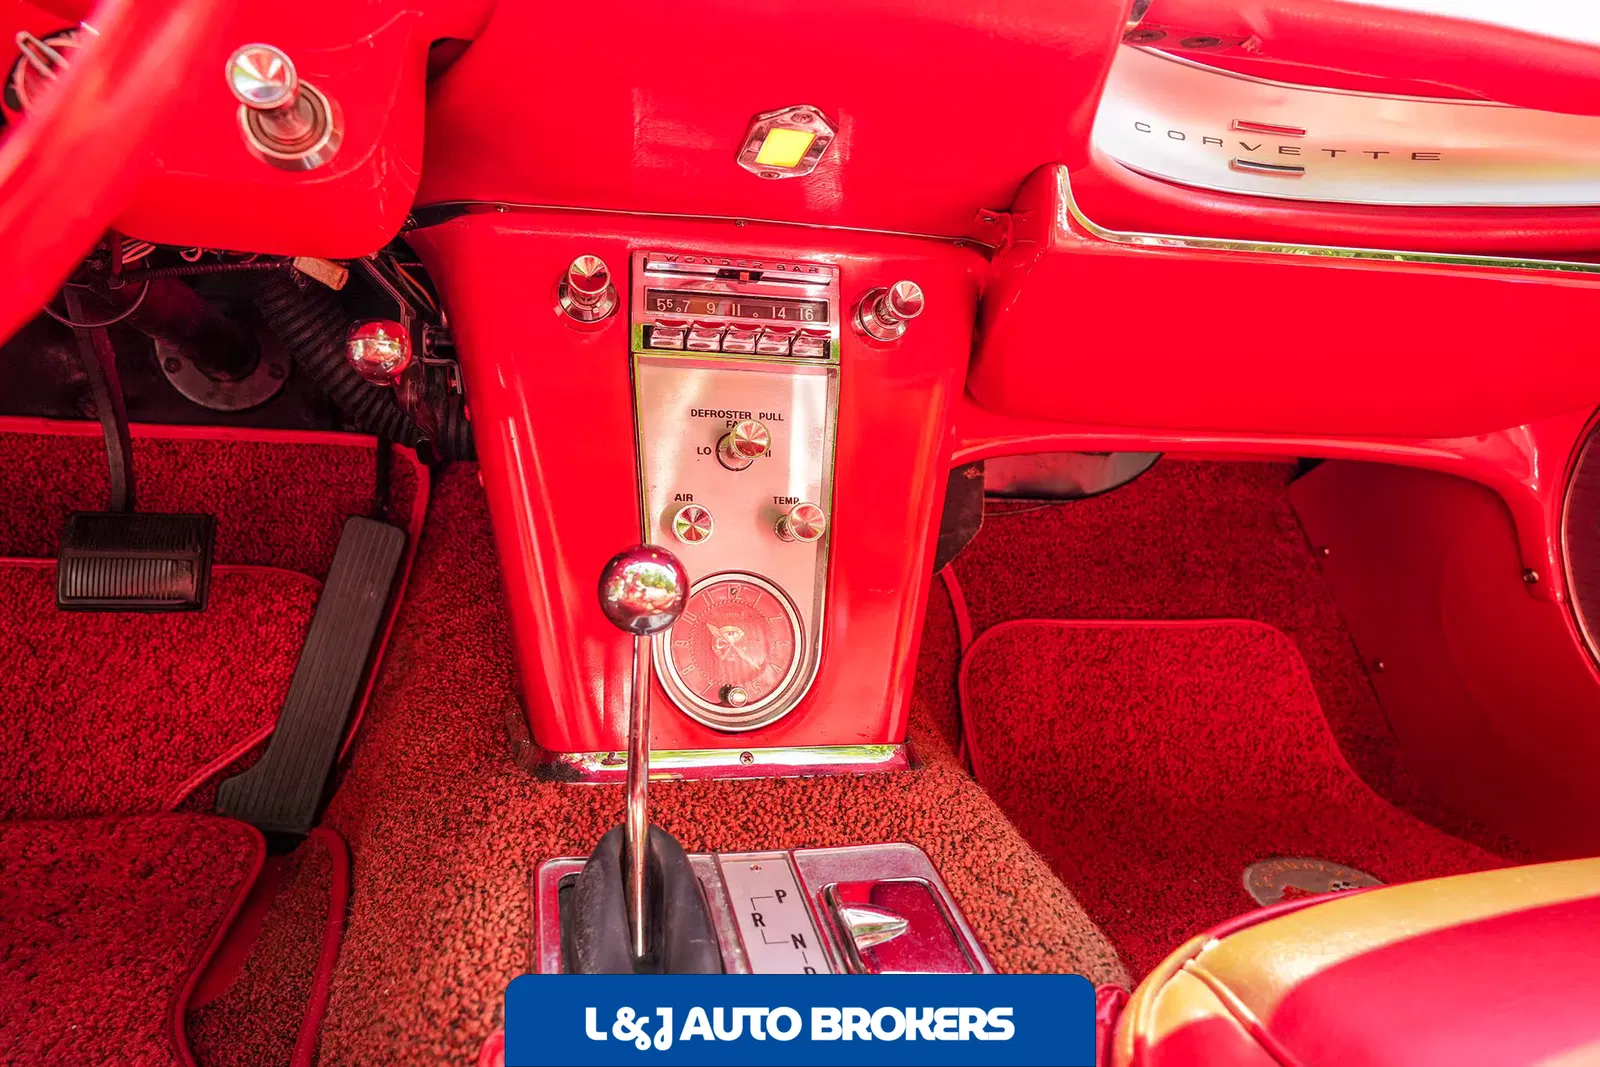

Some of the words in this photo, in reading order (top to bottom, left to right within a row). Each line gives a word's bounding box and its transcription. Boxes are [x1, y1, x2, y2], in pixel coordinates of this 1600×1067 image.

[1134, 121, 1442, 161] CORVETTE
[664, 254, 763, 269] WONDER
[776, 264, 819, 274] BAR
[682, 300, 691, 313] 7
[706, 302, 716, 315] 9
[731, 303, 741, 317] 11
[771, 306, 787, 319] 14
[799, 307, 814, 321] 16
[690, 408, 752, 420] DEFROSTER
[758, 412, 784, 422] PULL
[697, 446, 712, 455] LO
[674, 493, 694, 502] AIR
[774, 889, 787, 904] P
[751, 912, 766, 927] R
[791, 933, 807, 949] N
